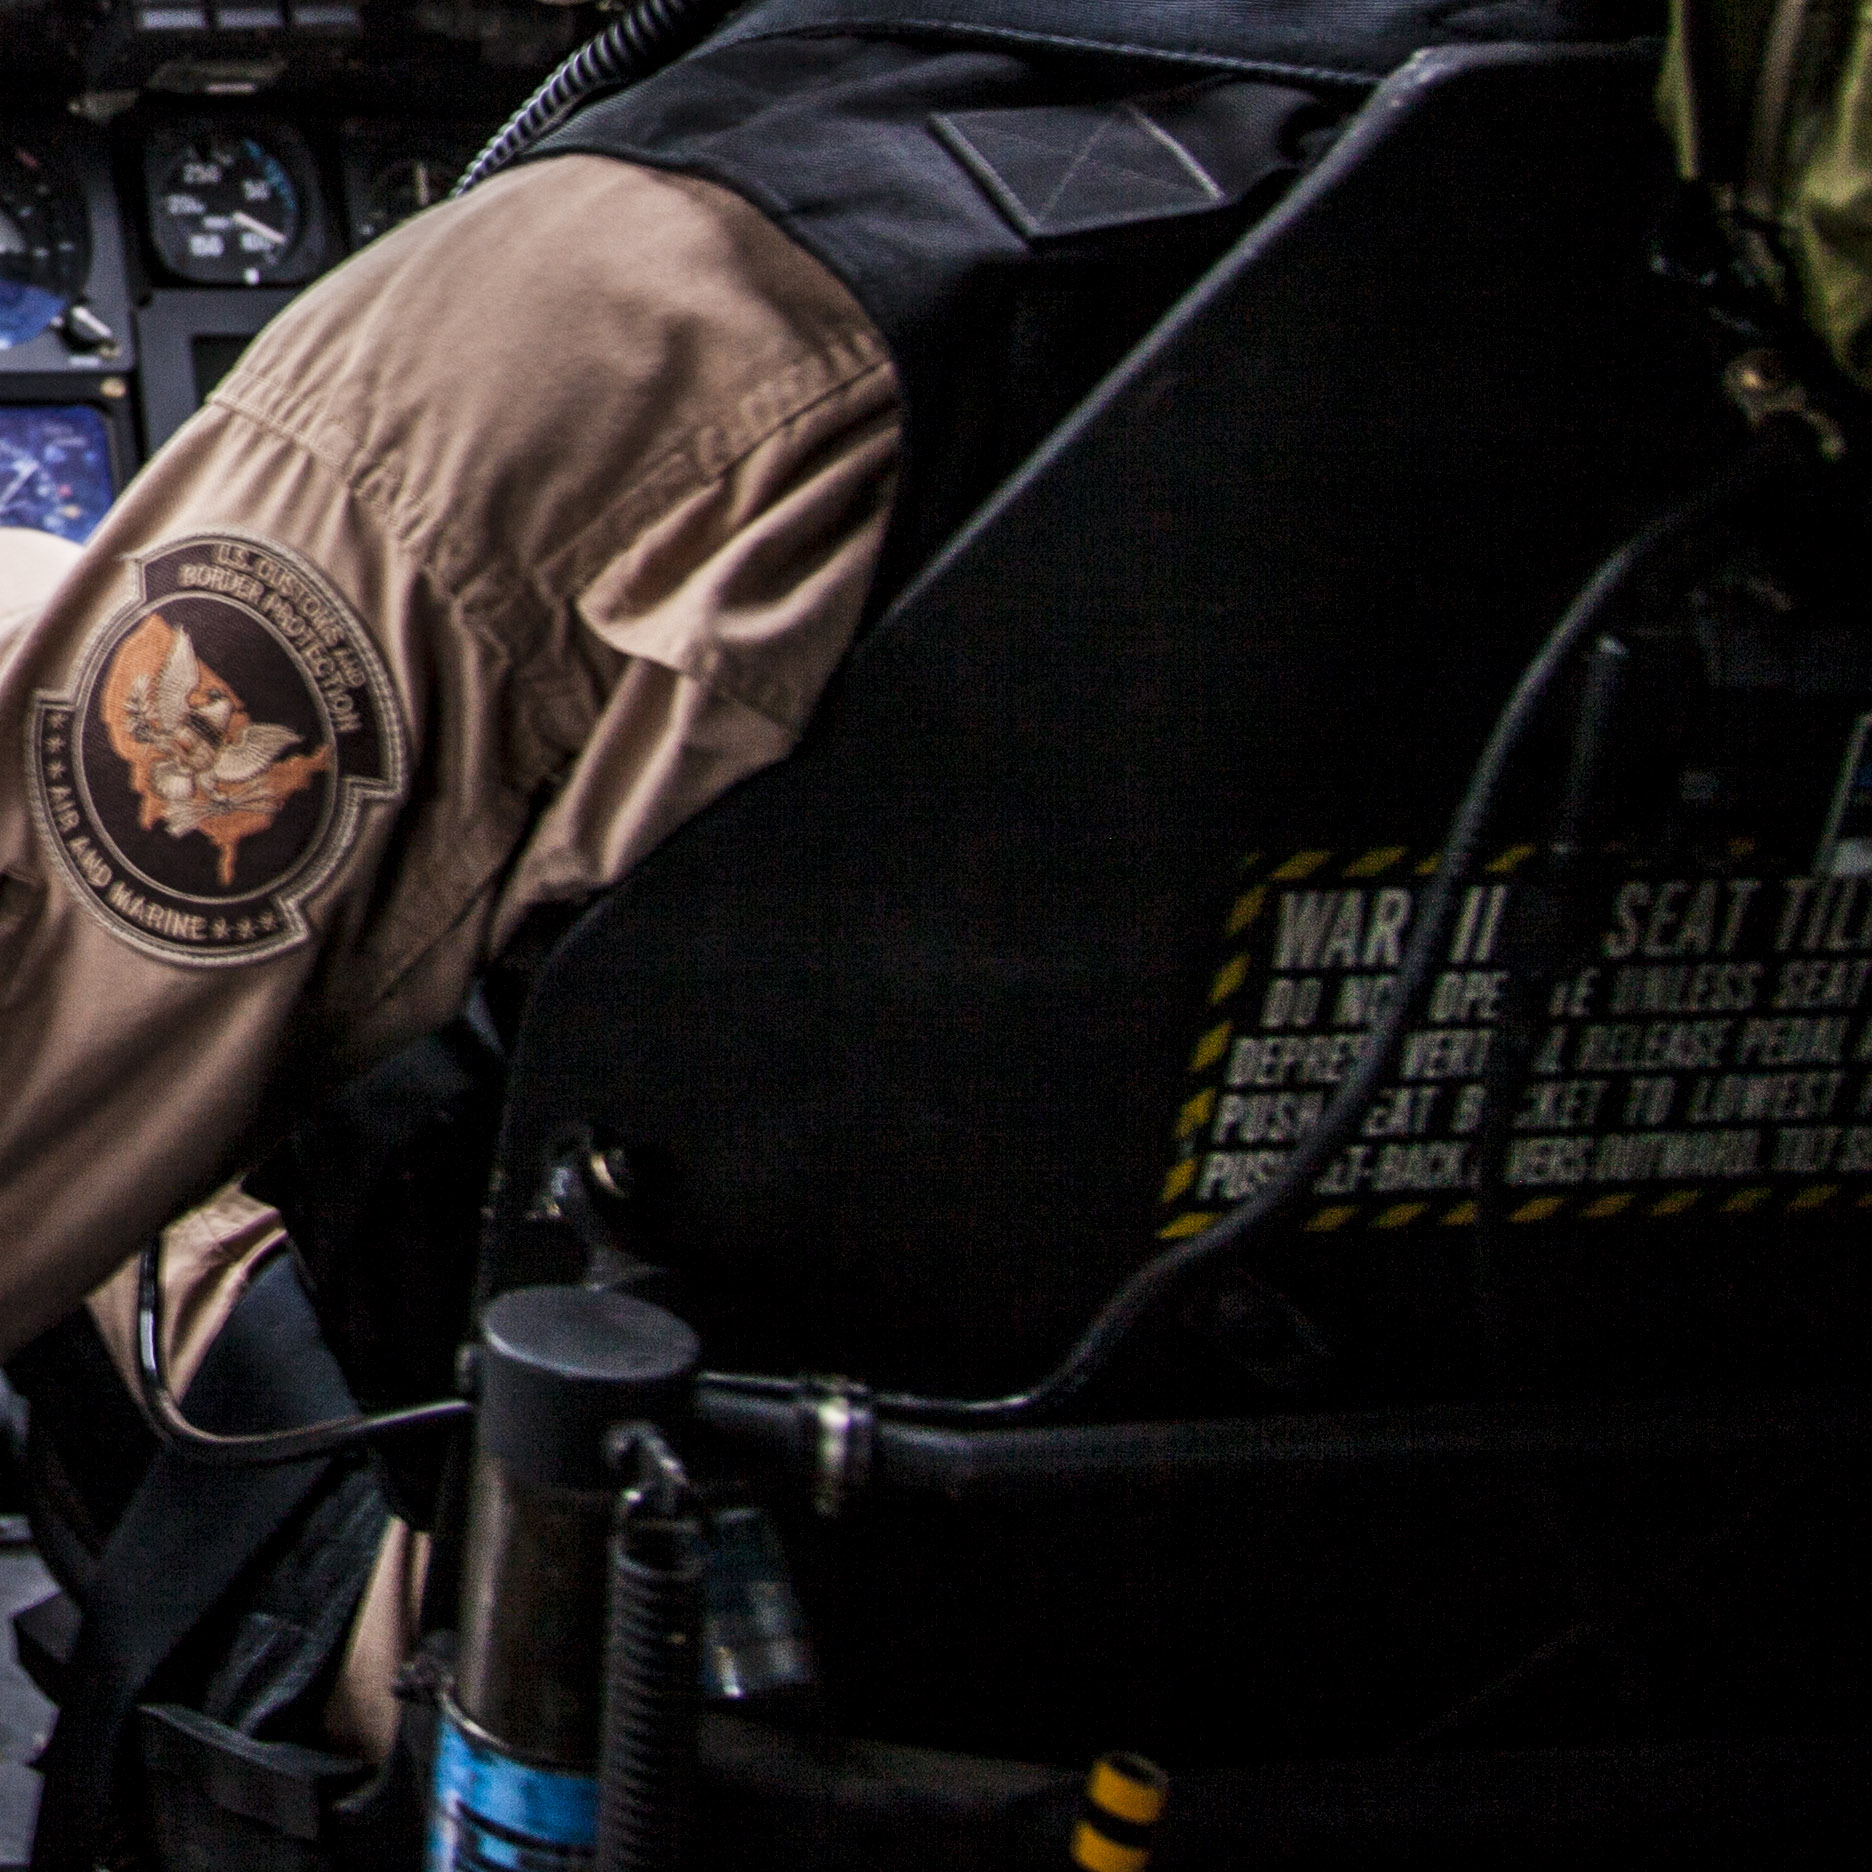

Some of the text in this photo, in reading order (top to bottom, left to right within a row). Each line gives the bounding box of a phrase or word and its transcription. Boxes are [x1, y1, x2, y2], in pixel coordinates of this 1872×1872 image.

[253, 555, 344, 645] CUSTOMS
[178, 562, 363, 735] BORDER PROTECTION
[45, 787, 211, 941] AIR AND MARINE
[1601, 879, 1763, 959] SEAT
[1259, 976, 1323, 1028] DO
[1610, 961, 1765, 1014] UNLESS
[1573, 1018, 1735, 1071] RELEASE
[1738, 1015, 1851, 1067] PEDAL
[1621, 1075, 1678, 1126] TO
[1687, 1070, 1847, 1124] LOWEST
